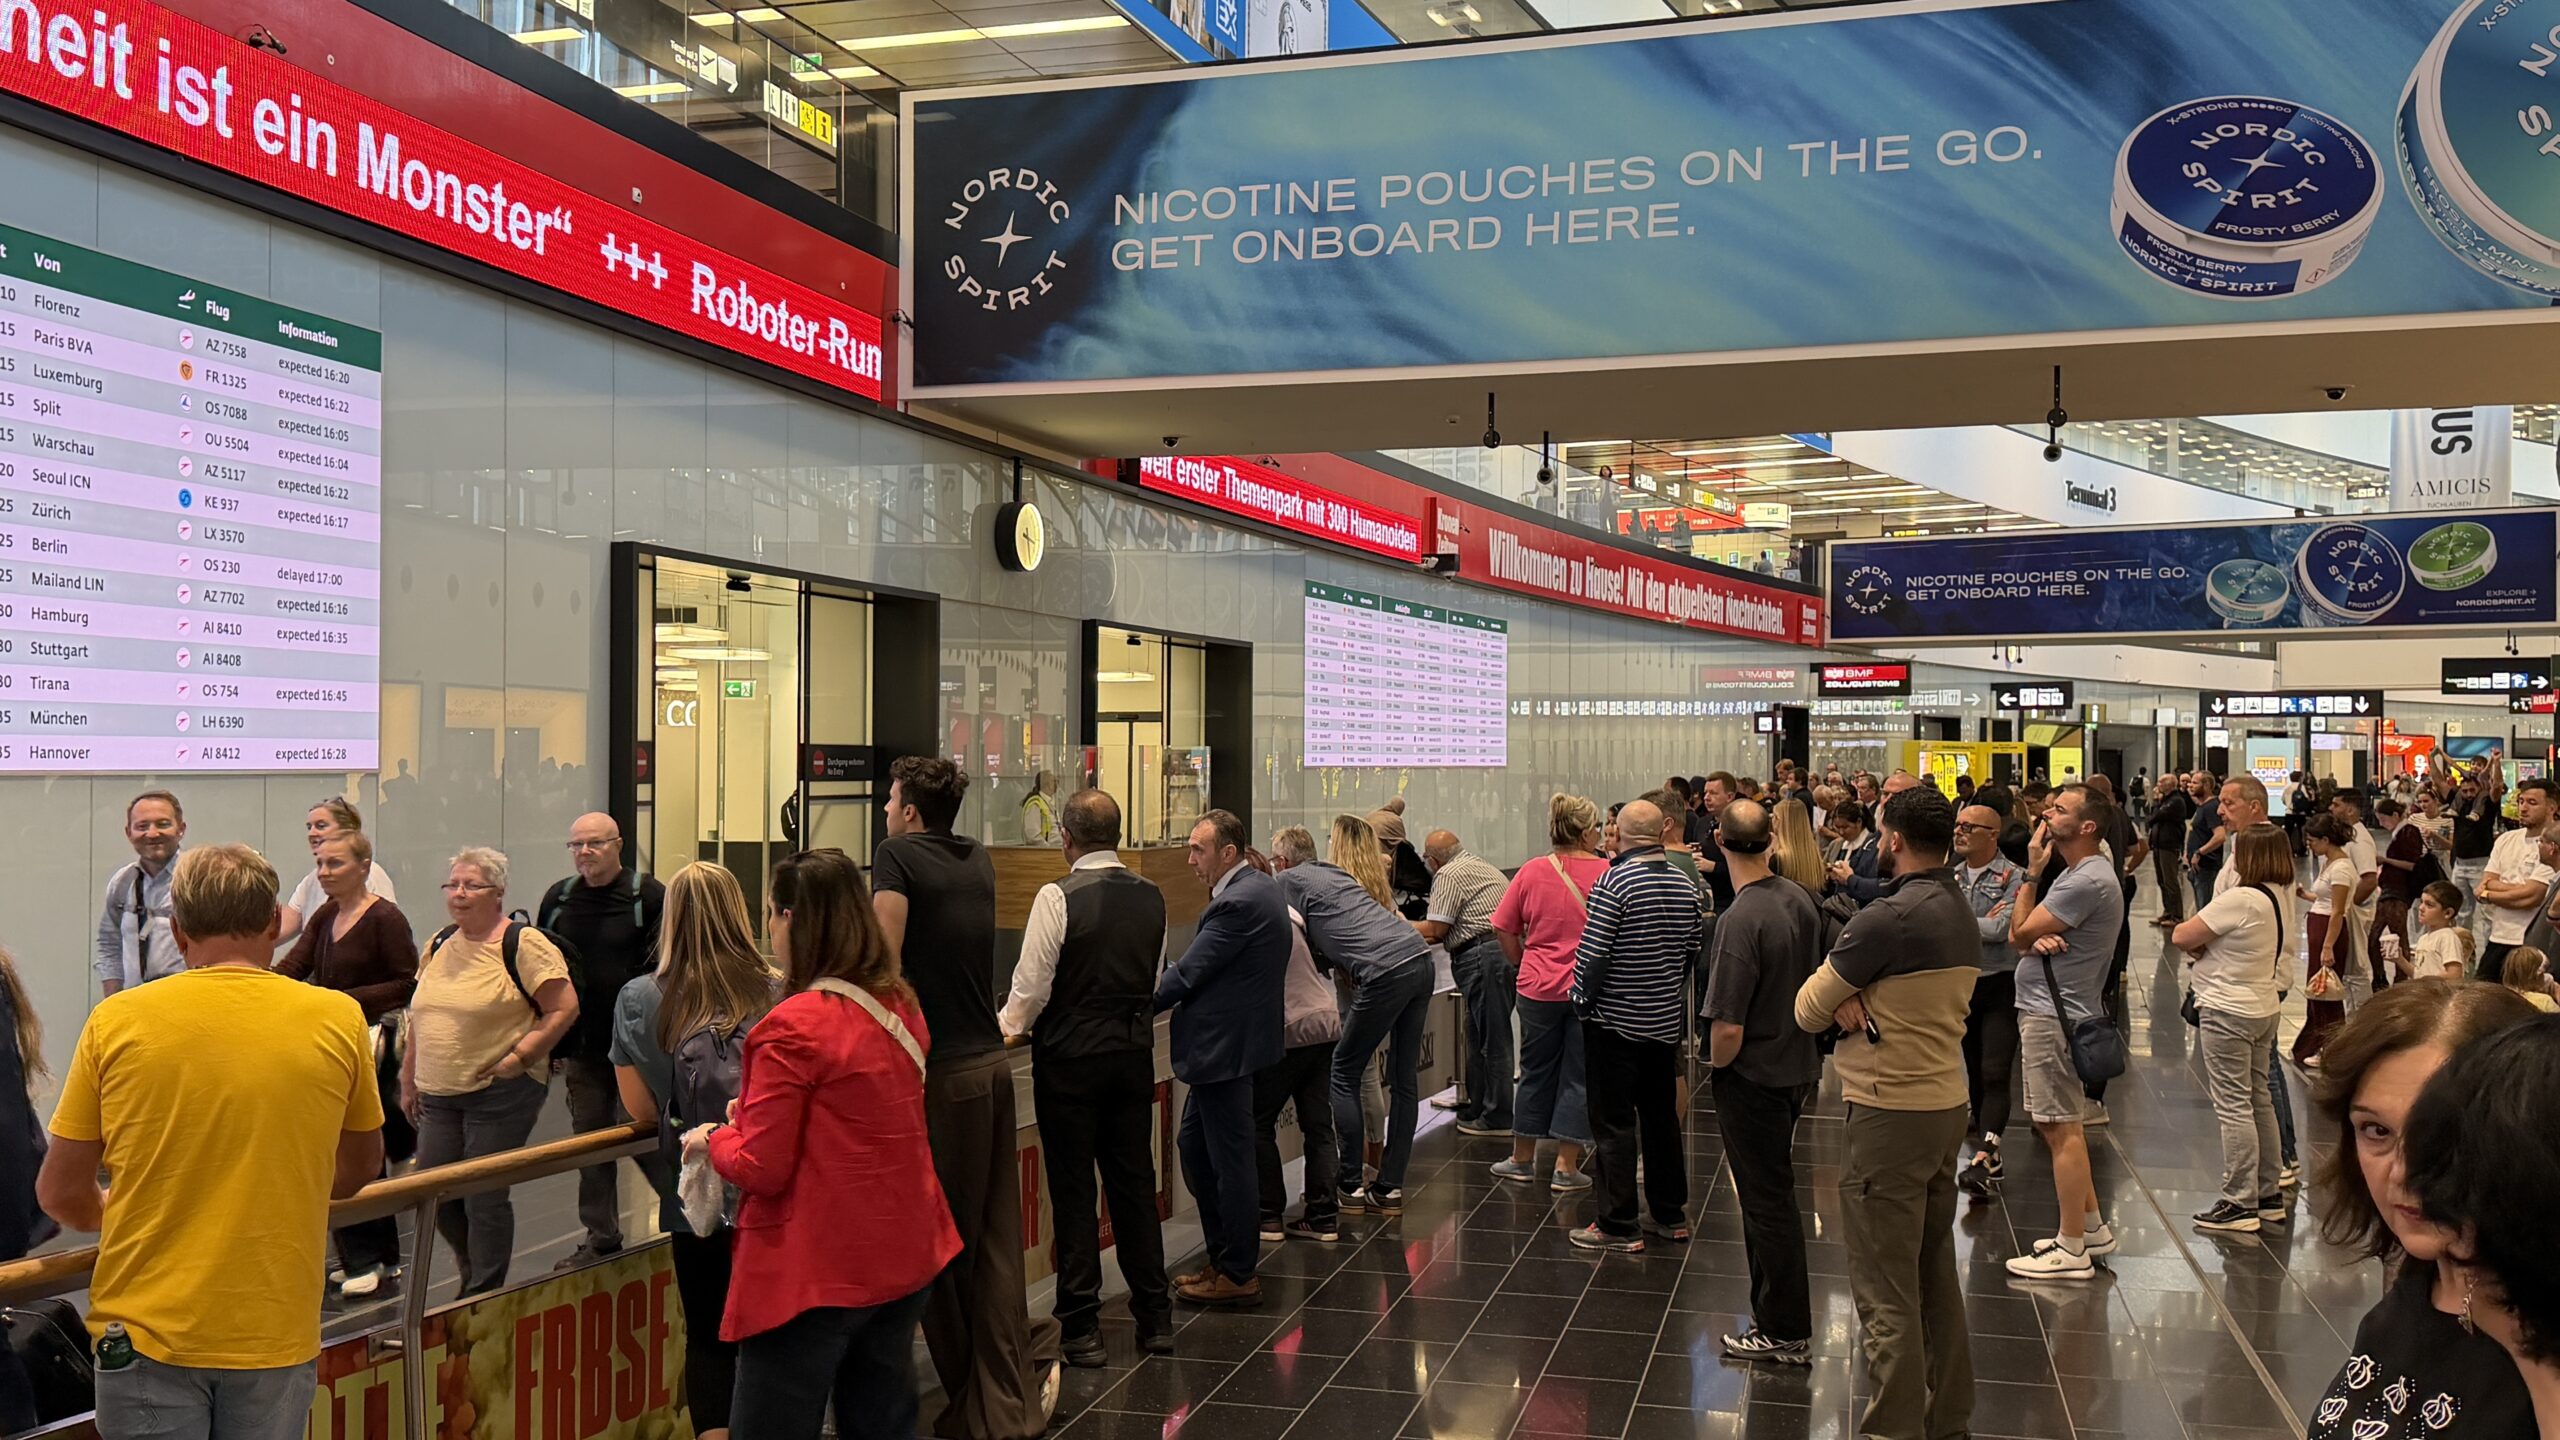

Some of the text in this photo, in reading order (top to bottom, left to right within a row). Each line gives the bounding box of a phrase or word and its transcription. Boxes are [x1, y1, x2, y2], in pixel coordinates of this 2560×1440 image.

[158, 38, 233, 138] ist
[253, 94, 337, 177] ein
[2166, 101, 2239, 125] X-STRONG
[2190, 122, 2326, 166] NORDIC
[2300, 113, 2364, 169] NICOTINE POUCHES
[1113, 126, 2042, 226] NICOTINE POUCHES ON THE GO.
[2182, 161, 2320, 209] SPIRIT
[945, 167, 1071, 229] NORDIC
[2422, 165, 2546, 273] FROSTY MINT
[1111, 202, 1697, 271] GET ONBOARD HERE.
[2215, 209, 2341, 235] FROSTY BERRY
[2125, 234, 2278, 292] NORDIC SPIRIT
[2147, 234, 2247, 273] FROSTY BERRY
[34, 252, 338, 348] Von Flug Information
[944, 250, 1068, 312] SPIRIT
[34, 294, 81, 319] Florenz
[206, 339, 219, 352] AZ
[223, 342, 246, 358] 7558
[279, 357, 322, 378] expected
[325, 368, 349, 384] 16:20
[35, 329, 64, 348] Paris
[68, 337, 92, 355] BVA
[206, 370, 219, 383] FR
[222, 374, 246, 389] 1325
[279, 389, 321, 406] expected
[325, 398, 348, 413] 16:22
[34, 364, 102, 393] Luxemburg
[206, 401, 220, 414] OS
[223, 405, 247, 420] 7088
[279, 420, 321, 436] expected
[324, 427, 348, 442] 16:05
[34, 399, 61, 416] Split
[205, 433, 221, 446] OU
[225, 437, 249, 451] 5504
[279, 450, 321, 465] expected
[324, 456, 348, 470] 16:04
[33, 433, 94, 456] Warschau
[205, 464, 218, 477] AZ
[222, 467, 245, 481] 5117
[278, 480, 321, 495] expected
[324, 486, 348, 500] 16:22
[2410, 477, 2491, 497] AMICIS
[33, 469, 66, 485] Seoul
[70, 475, 90, 489] ICN
[205, 496, 217, 508] KE
[221, 498, 239, 511] 937
[278, 510, 320, 524] expected
[324, 515, 348, 528] 16:17
[1176, 458, 1416, 553] erster Themenpark mit 300 Humanoiden
[2065, 480, 2108, 510] Terminal
[32, 503, 70, 520] Zürich
[205, 527, 216, 540] LX
[220, 529, 244, 543] 3570
[33, 538, 67, 554] Berlin
[204, 559, 218, 571] OS
[222, 561, 240, 573] 230
[278, 568, 314, 584] delayed
[318, 573, 342, 585] 17:00
[2328, 540, 2383, 565] NORDIC
[32, 572, 81, 589] Mailand
[85, 577, 103, 591] LIN
[204, 590, 217, 602] AZ
[220, 591, 244, 605] 7702
[277, 600, 320, 613] expected
[323, 602, 348, 615] 16:16
[1489, 527, 1567, 593] Willkommen
[1570, 560, 1583, 596] zu
[1585, 555, 1624, 605] Hause!
[1627, 566, 1644, 609] Mit
[1646, 572, 1665, 614] den
[1668, 578, 1723, 624] aktuellsten
[1726, 590, 1785, 636] Nachrichten.
[1845, 565, 1892, 587] NORDIC
[1906, 566, 2190, 587] NICOTINE POUCHES ON THE GO.
[1906, 584, 2090, 601] GET ONBOARD HERE.
[2328, 565, 2384, 592] SPIRIT
[1845, 593, 1892, 614] SPIRIT
[32, 607, 347, 644] Hamburg AI 8410 expected 16:35
[31, 642, 241, 666] Stuttgart AI 8408
[1845, 669, 1874, 678] BMF
[30, 676, 347, 702] Tirana OS 754 expected 16:45
[2533, 694, 2556, 705] RELAY
[31, 709, 244, 728] München LH 6390
[30, 746, 346, 762] Hannover AI 8412 expected 16:28
[2251, 768, 2289, 779] CORSO
